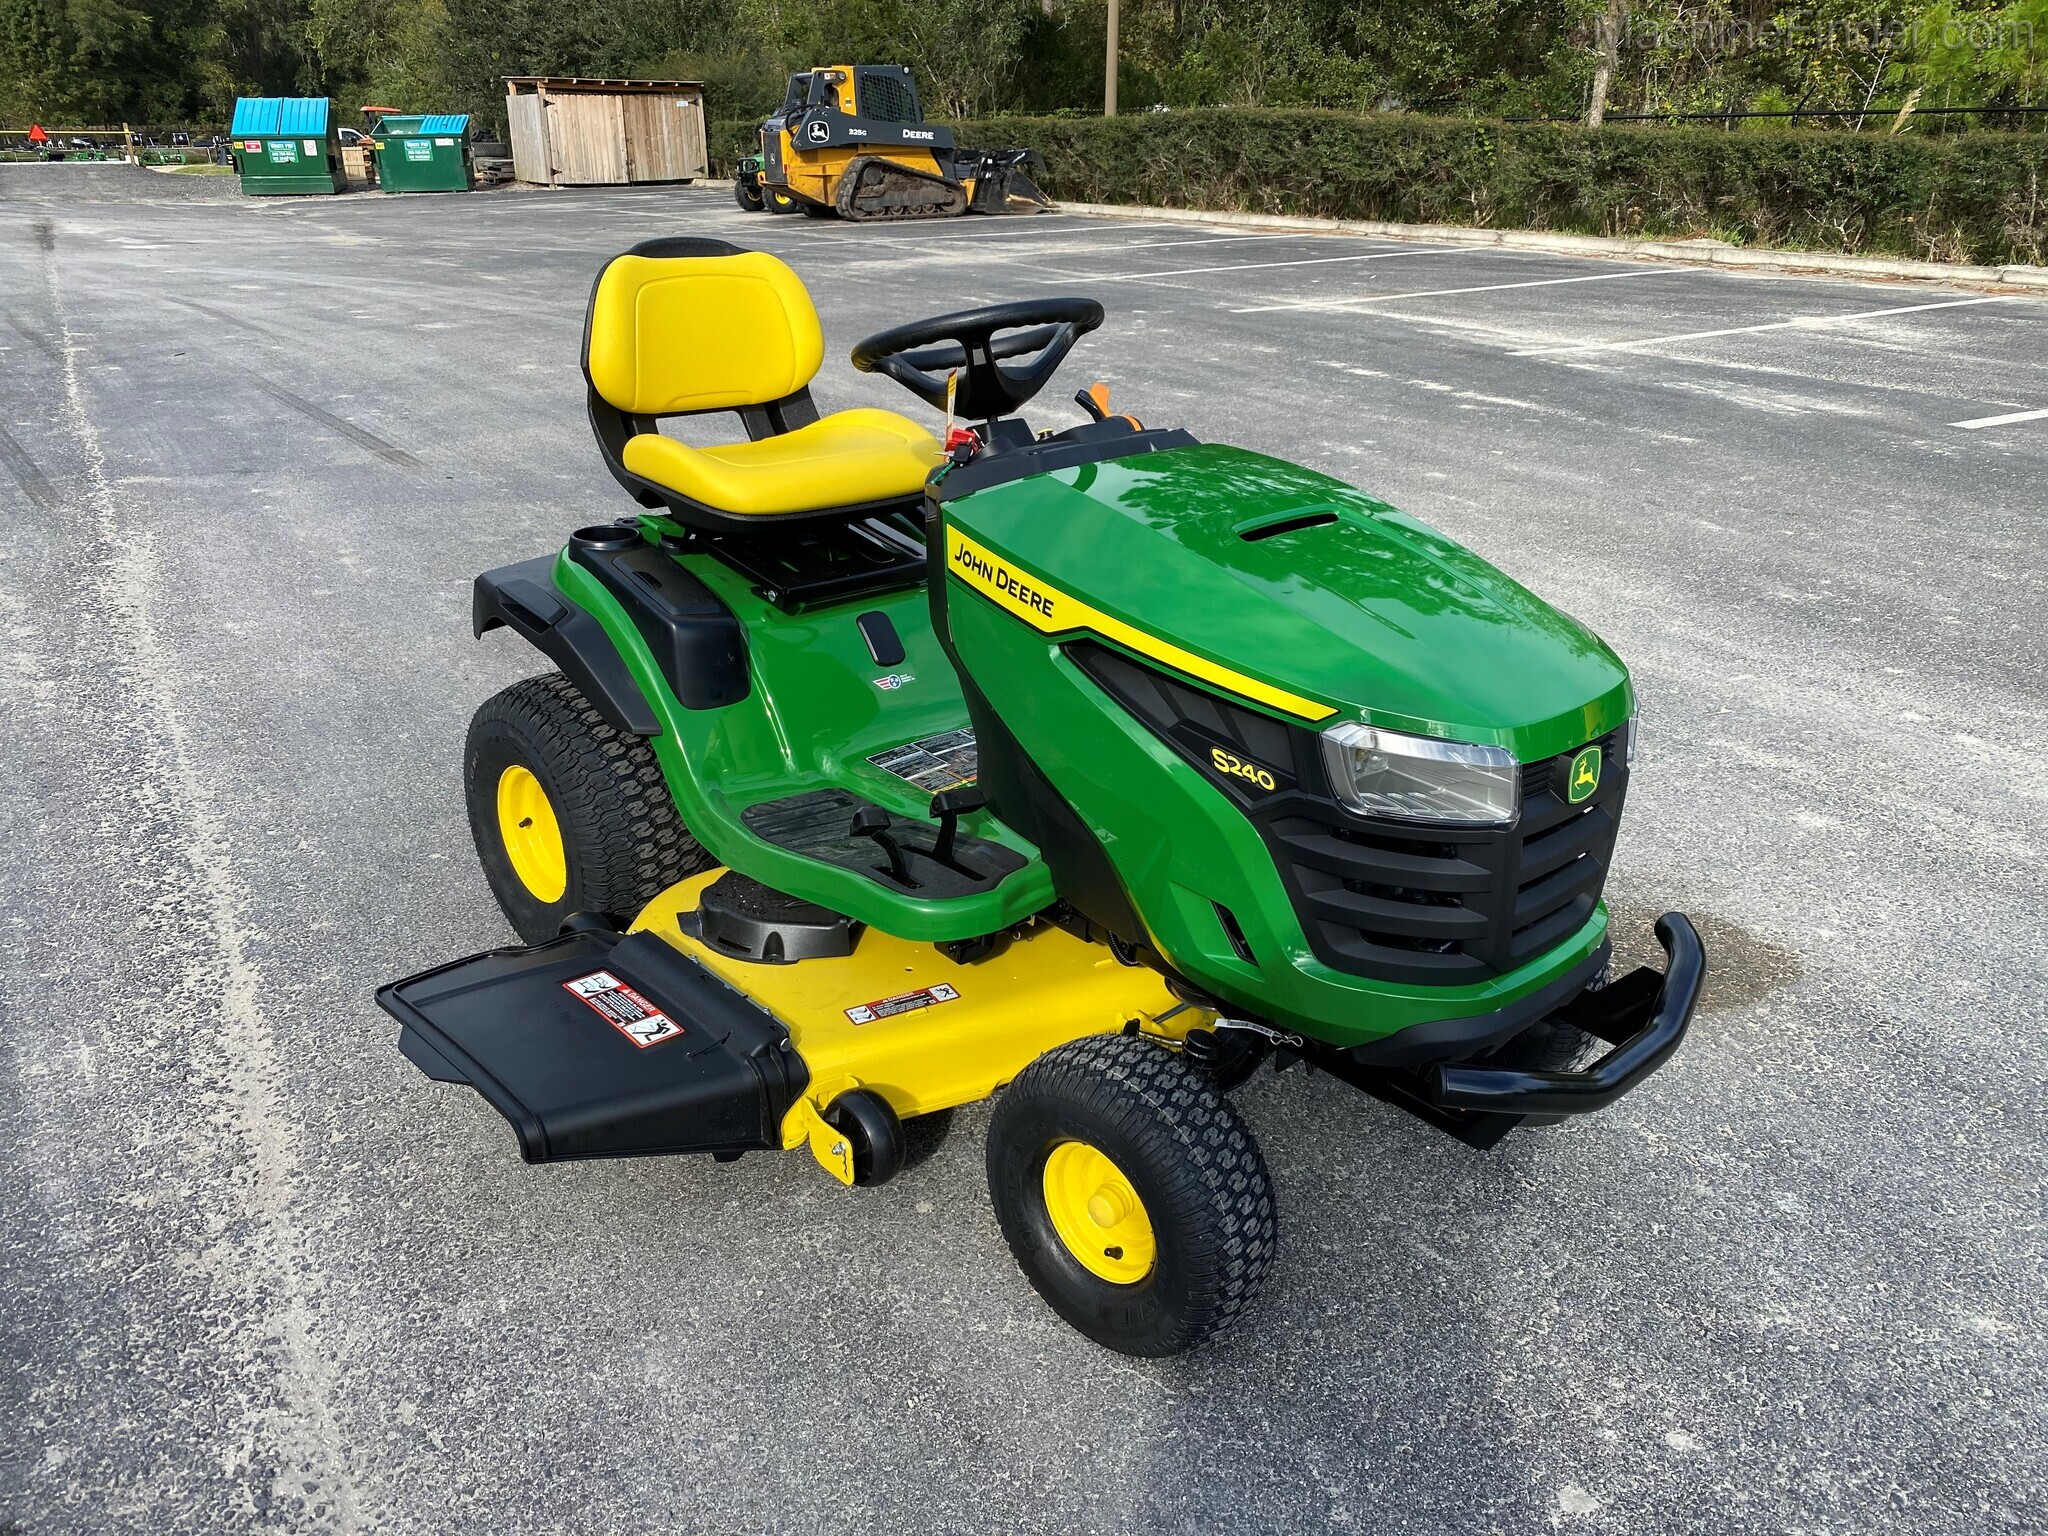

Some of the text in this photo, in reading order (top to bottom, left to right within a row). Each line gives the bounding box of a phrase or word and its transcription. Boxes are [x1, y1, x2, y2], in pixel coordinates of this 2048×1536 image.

[848, 128, 867, 136] 325G
[902, 128, 934, 140] DEERE
[954, 543, 1055, 619] JOHN DEERE
[1211, 748, 1275, 791] S240
[627, 992, 656, 1013] DANGER
